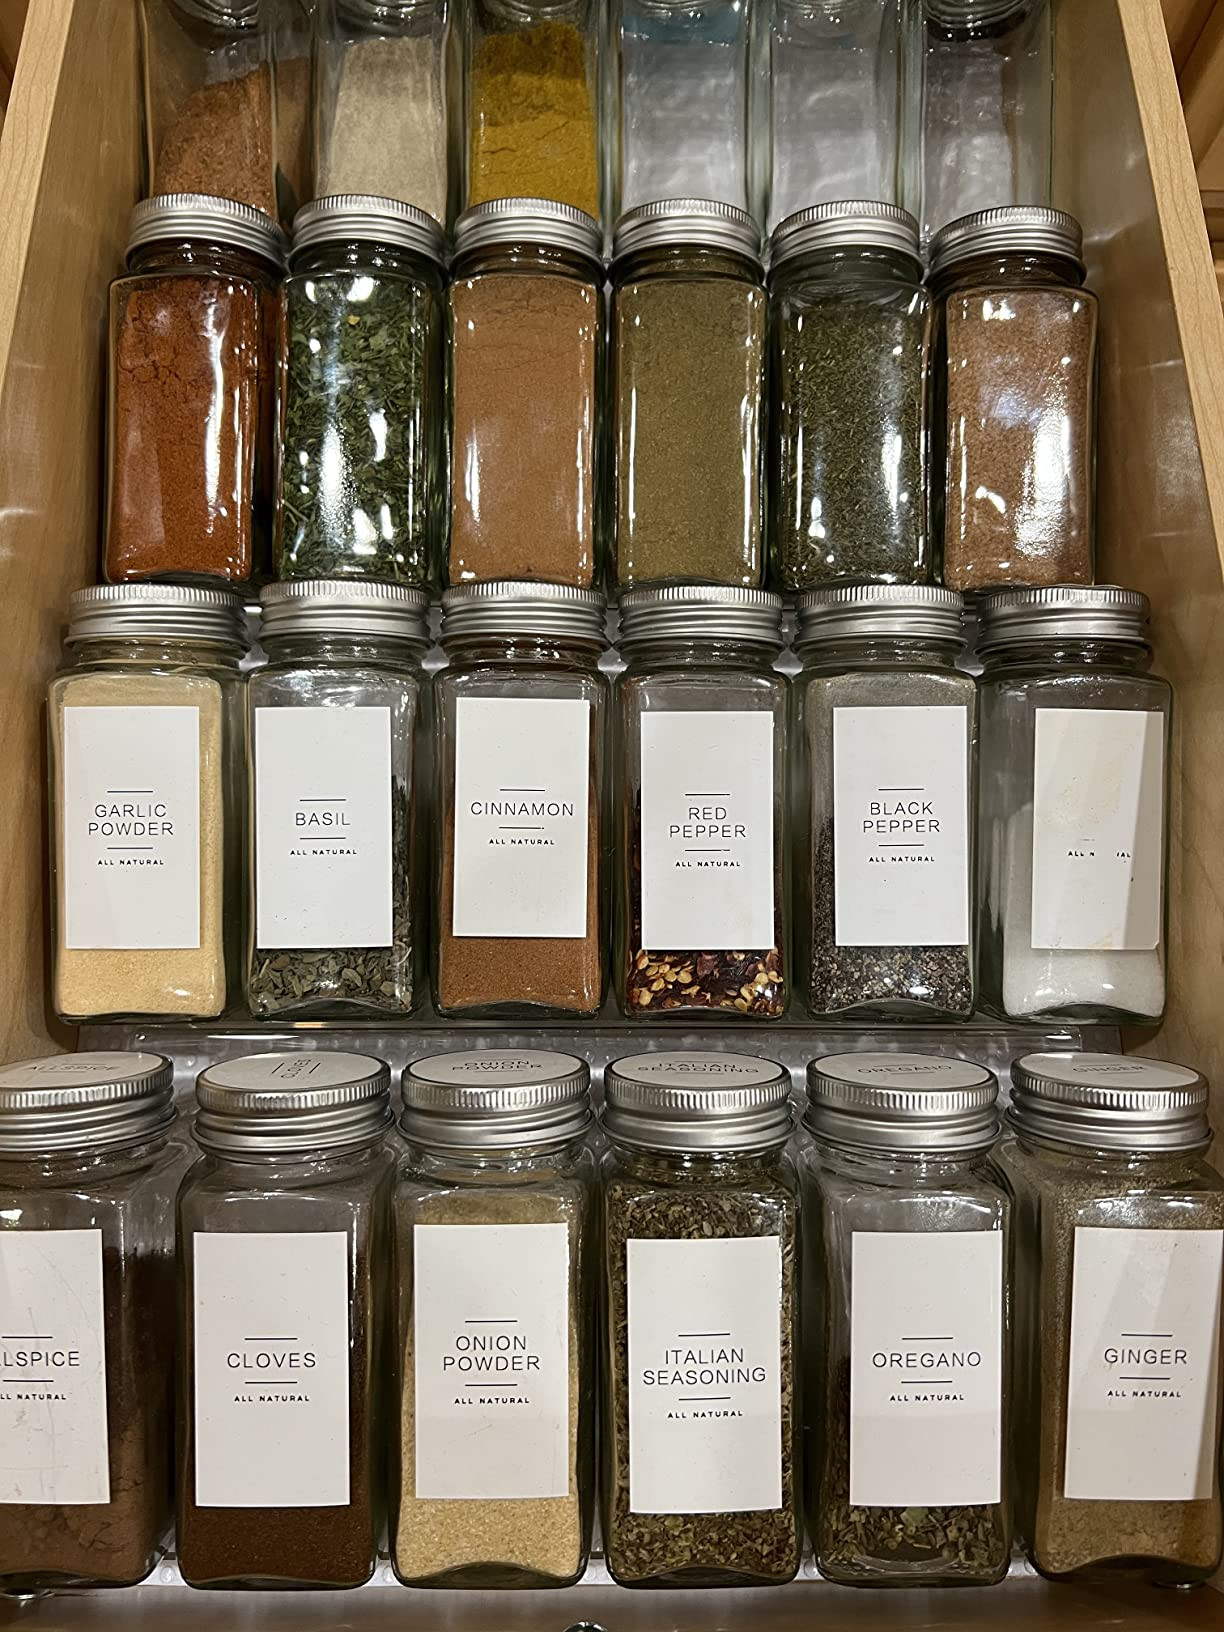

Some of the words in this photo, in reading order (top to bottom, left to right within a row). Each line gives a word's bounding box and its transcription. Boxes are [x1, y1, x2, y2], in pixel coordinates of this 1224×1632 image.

[94, 803, 167, 818] GARLIC
[470, 801, 574, 817] CINNAMON
[688, 806, 727, 821] RED
[870, 801, 934, 816] BLACK
[295, 811, 351, 827] BASIL
[862, 819, 941, 834] PEPPER
[88, 821, 174, 837] POWDER
[669, 824, 747, 839] PEPPER
[510, 838, 555, 846] NATURAL
[311, 848, 358, 856] NATURAL
[890, 855, 935, 863] NATURAL
[1067, 850, 1085, 858] ALL
[119, 858, 165, 866] NATURAL
[696, 860, 741, 868] NATURAL
[455, 1335, 527, 1353] ONION
[0, 1350, 81, 1368] LSPICE
[226, 1352, 316, 1369] CLOVES
[443, 1355, 541, 1372] POWDER
[665, 1347, 744, 1365] ITALIAN
[871, 1351, 982, 1369] OREGANO
[1104, 1347, 1187, 1365] GINGER
[642, 1366, 766, 1386] SEASONING
[16, 1393, 67, 1401] NATURAL
[233, 1395, 254, 1403] ALL
[258, 1394, 310, 1403] NATURAL
[454, 1397, 474, 1405] ALL
[479, 1397, 530, 1405] NATURAL
[889, 1394, 910, 1402] ALL
[914, 1393, 965, 1402] NATURAL
[1107, 1389, 1127, 1398] ALL
[1131, 1390, 1181, 1398] NATURAL
[667, 1411, 687, 1419] ALL
[692, 1410, 743, 1419] NATURAL
